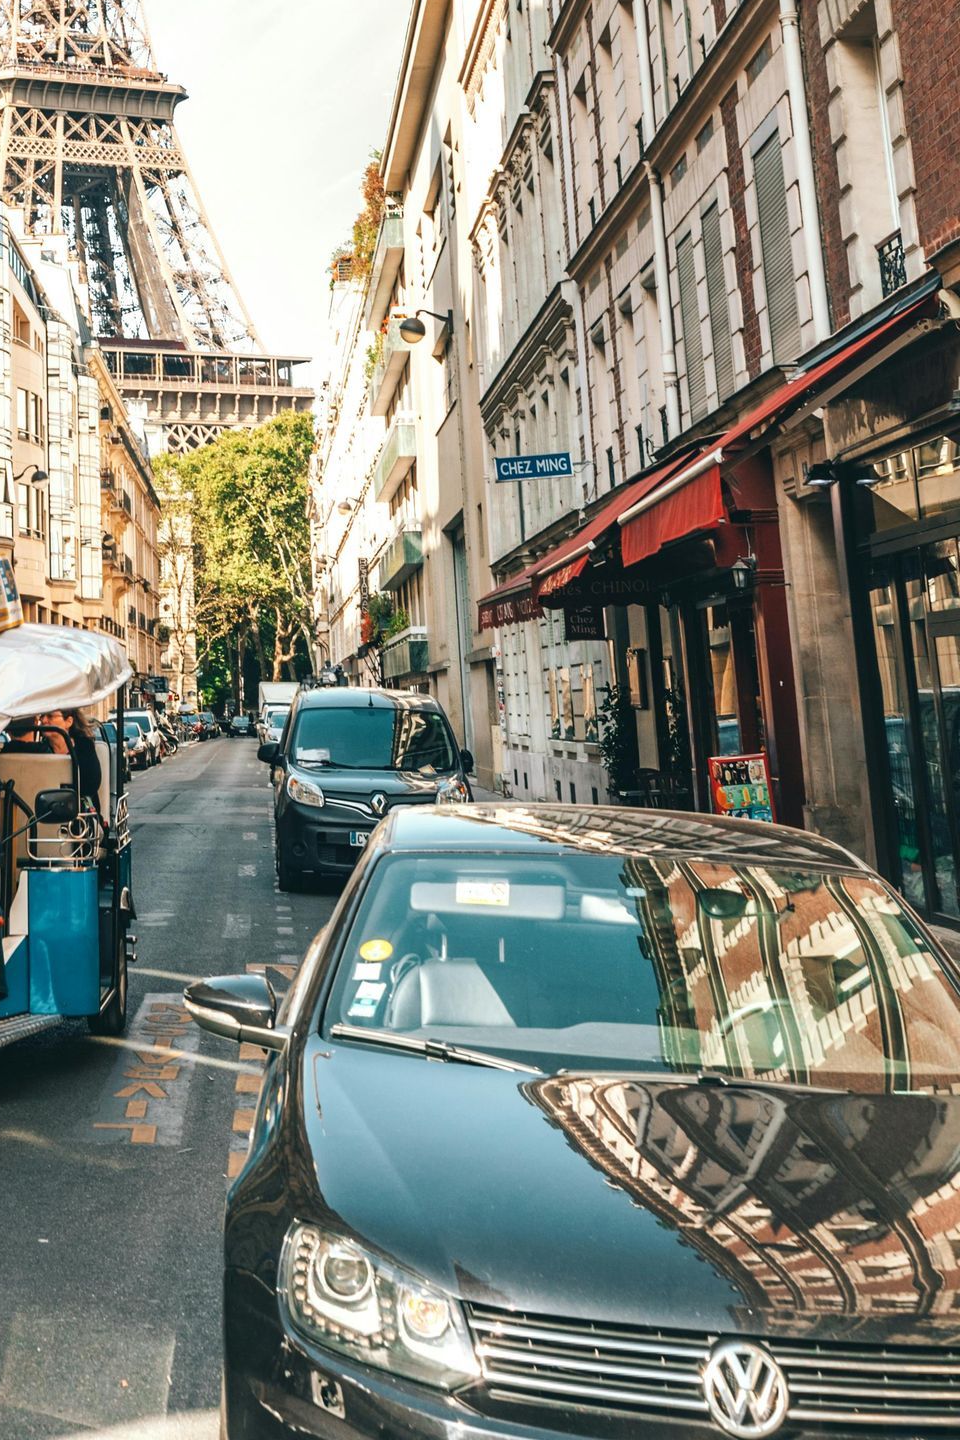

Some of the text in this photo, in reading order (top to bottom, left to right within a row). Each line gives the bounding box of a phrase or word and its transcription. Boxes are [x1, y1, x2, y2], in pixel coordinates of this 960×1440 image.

[500, 457, 568, 476] CHEZ MING
[359, 558, 369, 611] RESTAURAN
[569, 614, 594, 624] Chez
[571, 624, 597, 635] Ming
